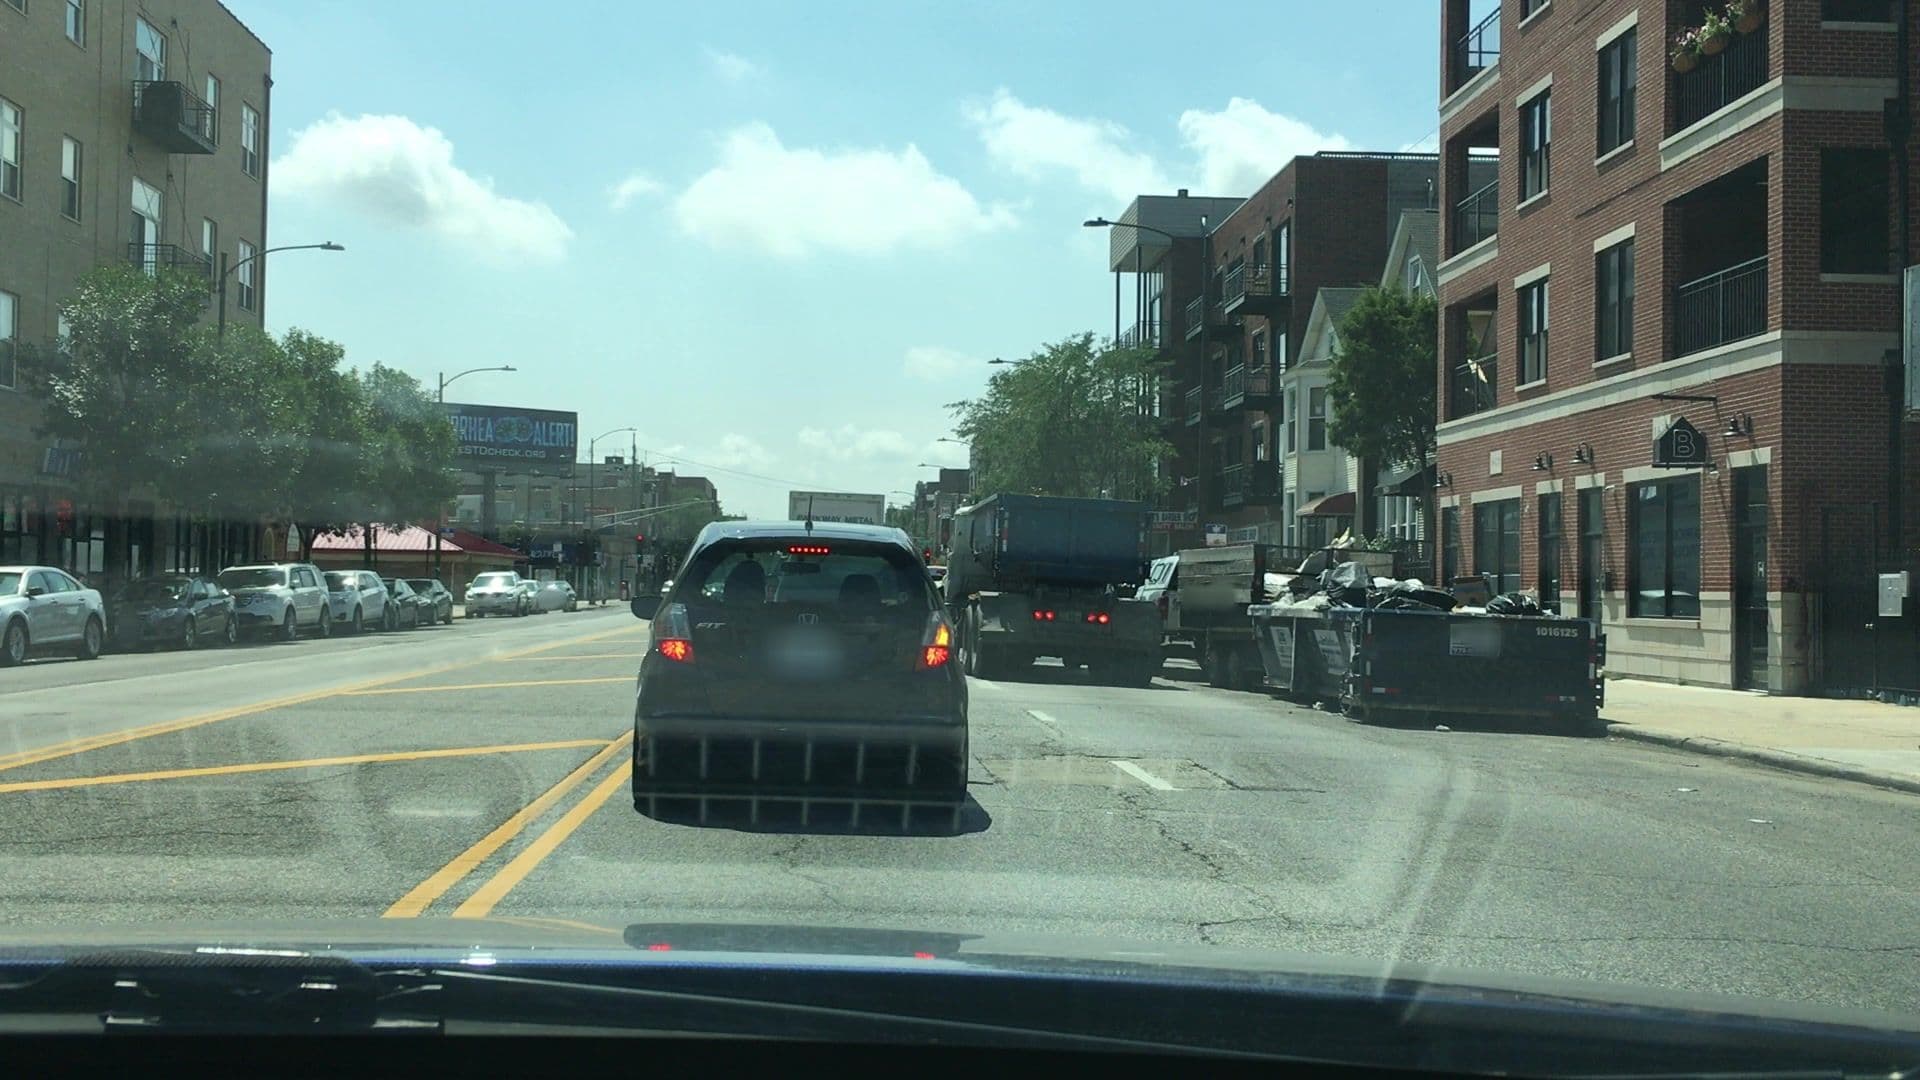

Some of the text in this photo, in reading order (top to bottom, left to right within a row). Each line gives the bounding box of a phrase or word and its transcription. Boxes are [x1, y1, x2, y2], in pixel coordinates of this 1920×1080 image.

[533, 421, 575, 448] ALERT!
[1673, 429, 1695, 458] B
[1536, 627, 1578, 637] 1016125
